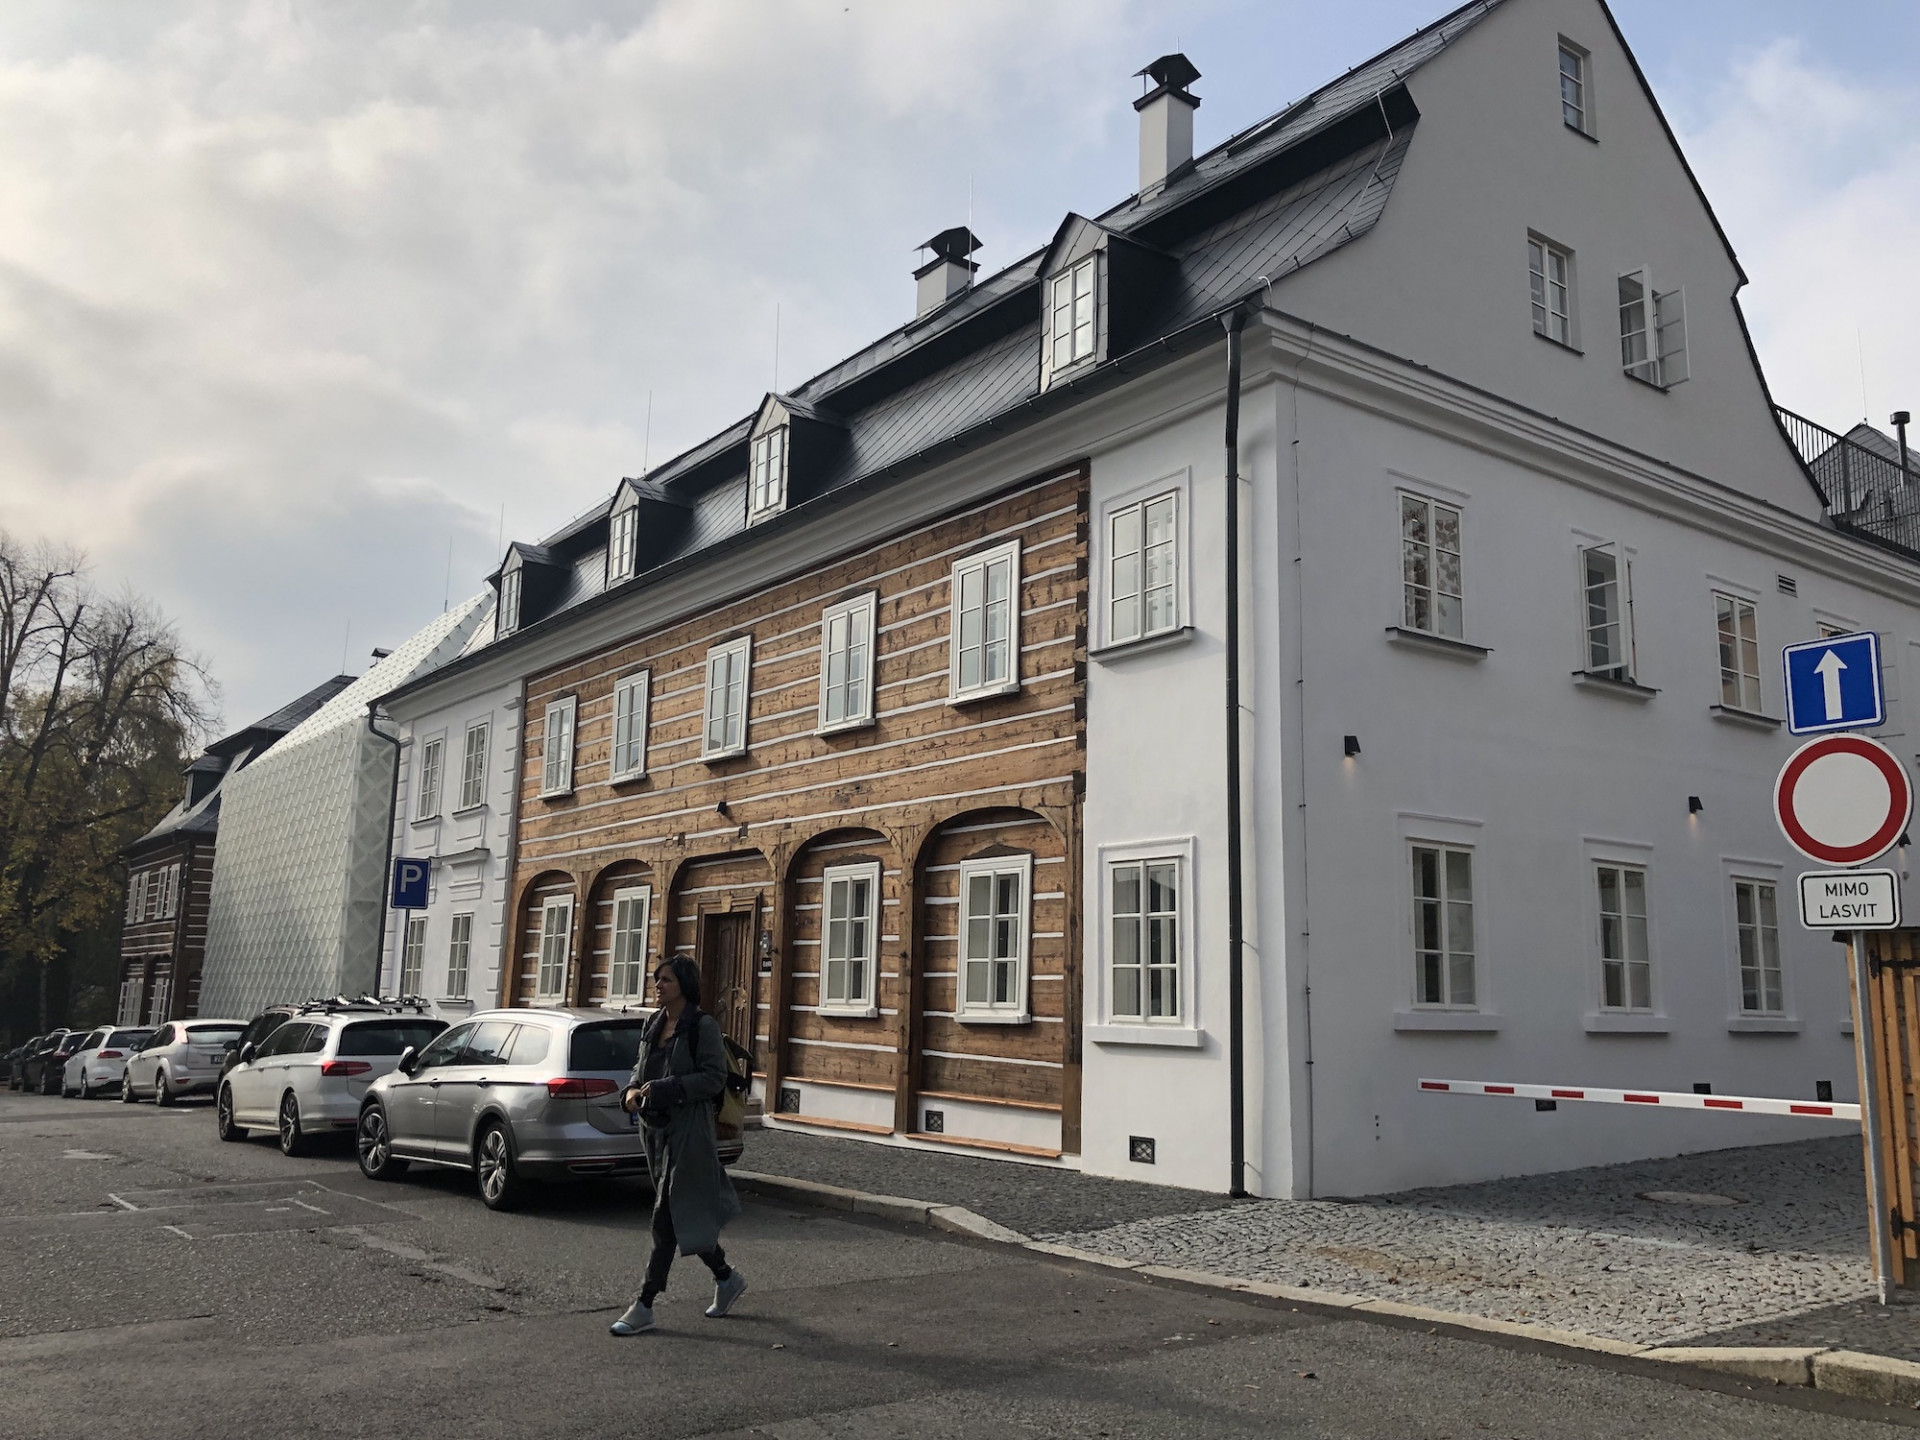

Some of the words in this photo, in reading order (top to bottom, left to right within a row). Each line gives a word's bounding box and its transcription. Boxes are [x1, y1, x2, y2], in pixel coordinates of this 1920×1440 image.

[400, 864, 423, 893] P
[1825, 882, 1869, 897] MIMO
[1819, 903, 1878, 919] LASVIT
